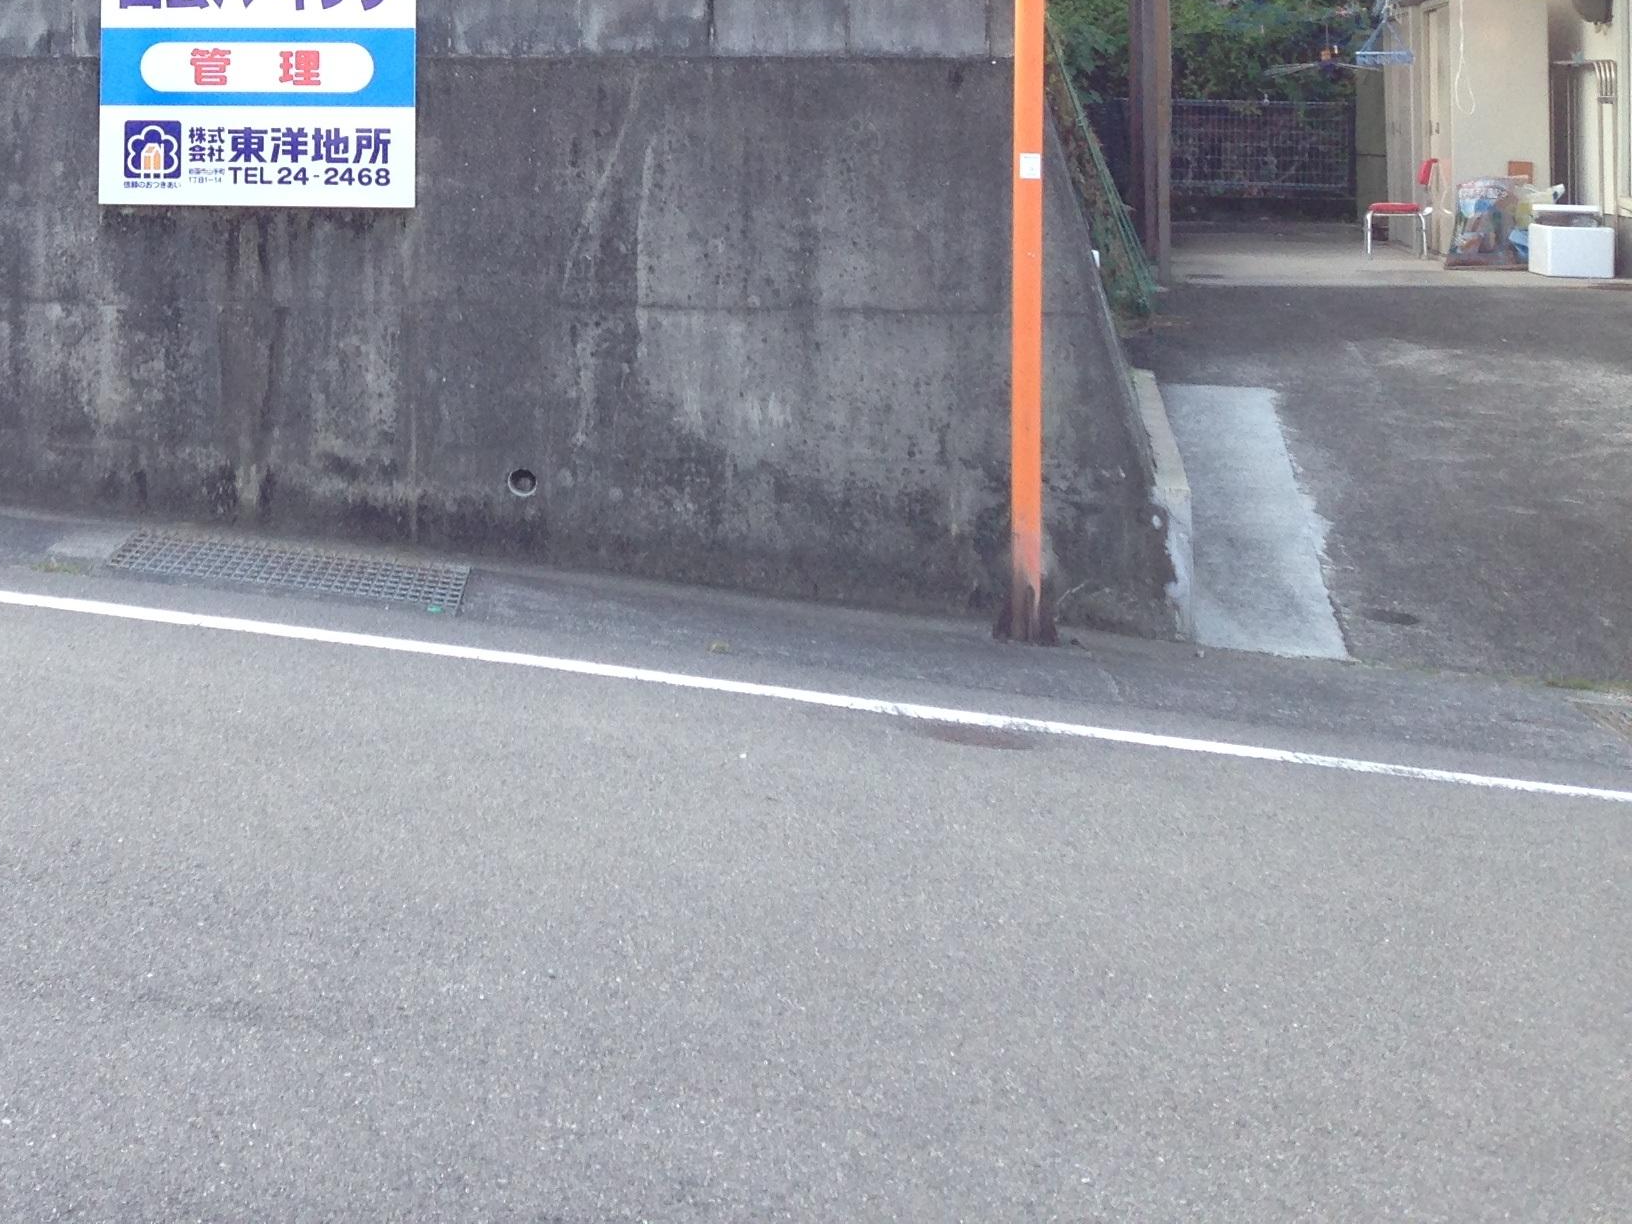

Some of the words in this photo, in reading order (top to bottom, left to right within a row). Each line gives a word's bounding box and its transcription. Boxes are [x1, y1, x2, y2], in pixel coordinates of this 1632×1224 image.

[190, 48, 321, 86] 管理
[188, 126, 225, 144] 株式
[227, 127, 392, 164] 東洋地所
[188, 144, 225, 163] 会社
[228, 167, 273, 185] TEL
[276, 166, 391, 187] 24-2468
